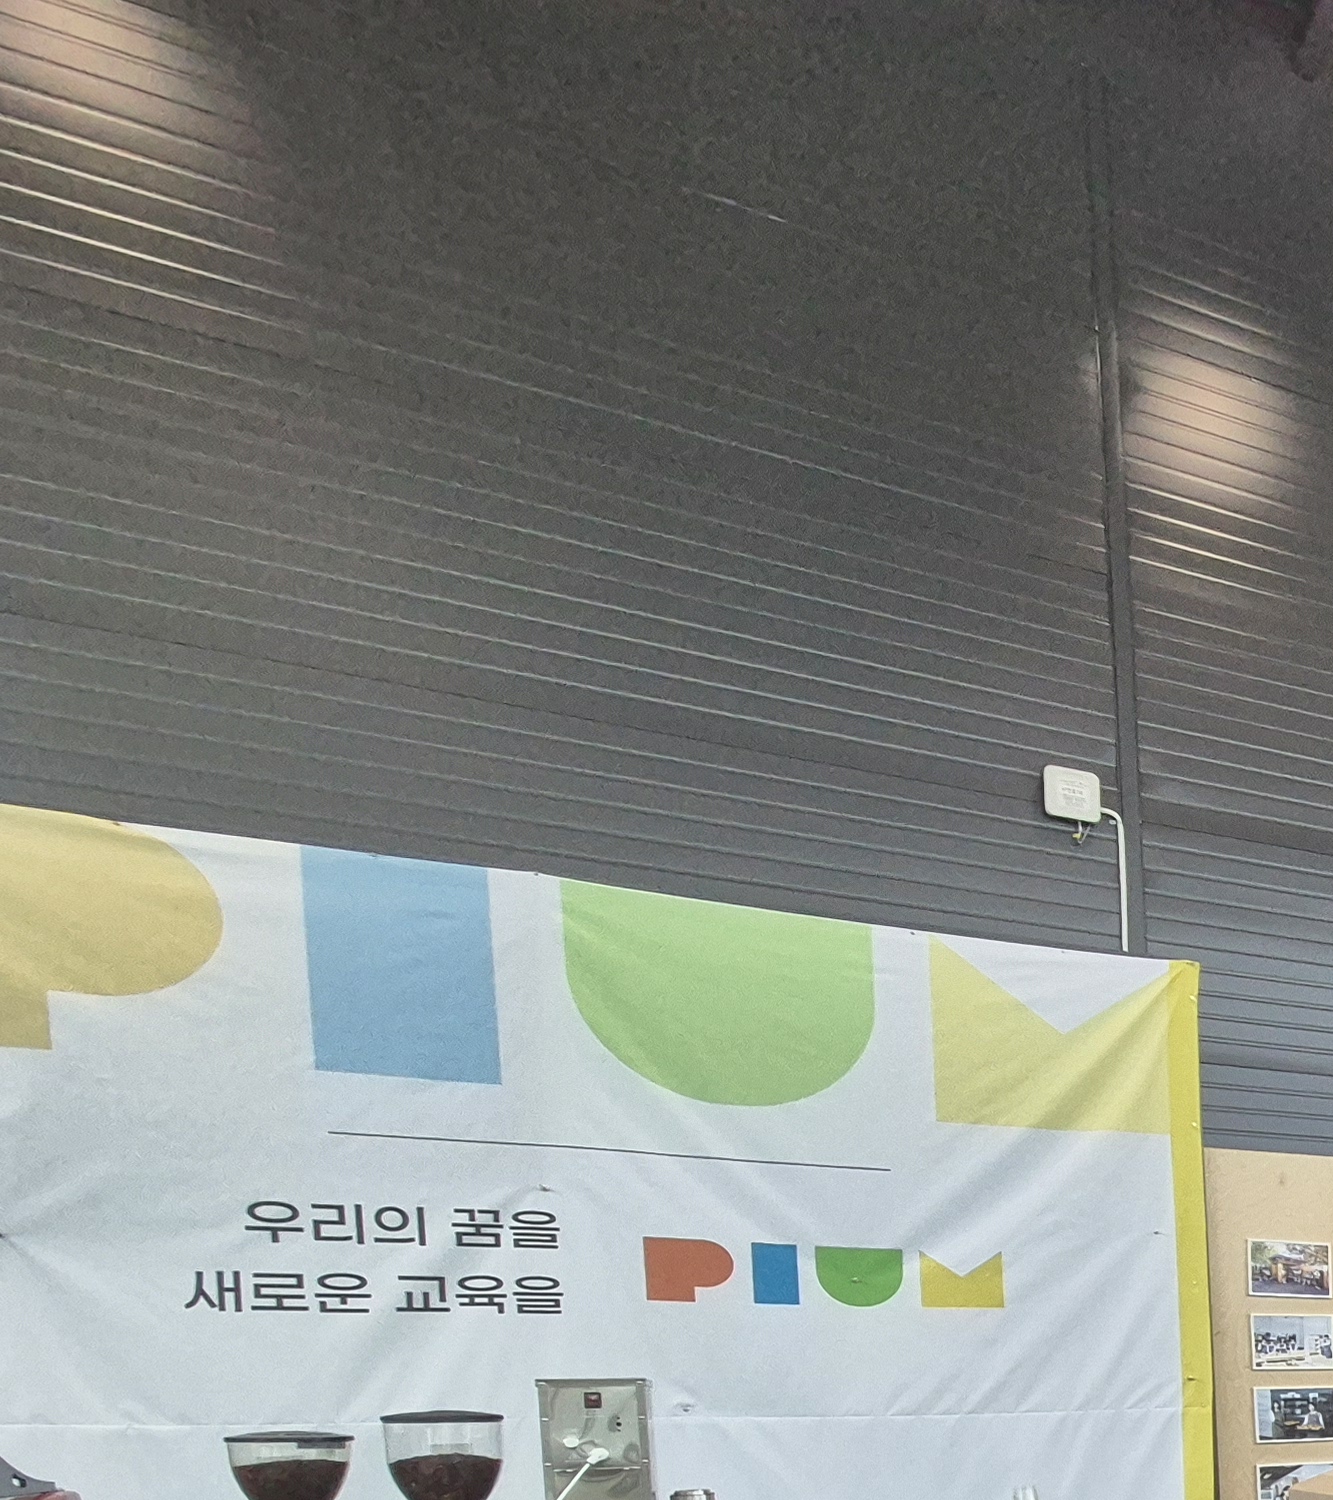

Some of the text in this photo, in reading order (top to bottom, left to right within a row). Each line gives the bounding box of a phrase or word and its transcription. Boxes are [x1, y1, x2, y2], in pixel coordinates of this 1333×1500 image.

[244, 1200, 562, 1251] 우리의 꿈을
[184, 1270, 566, 1316] 새로운 교육을
